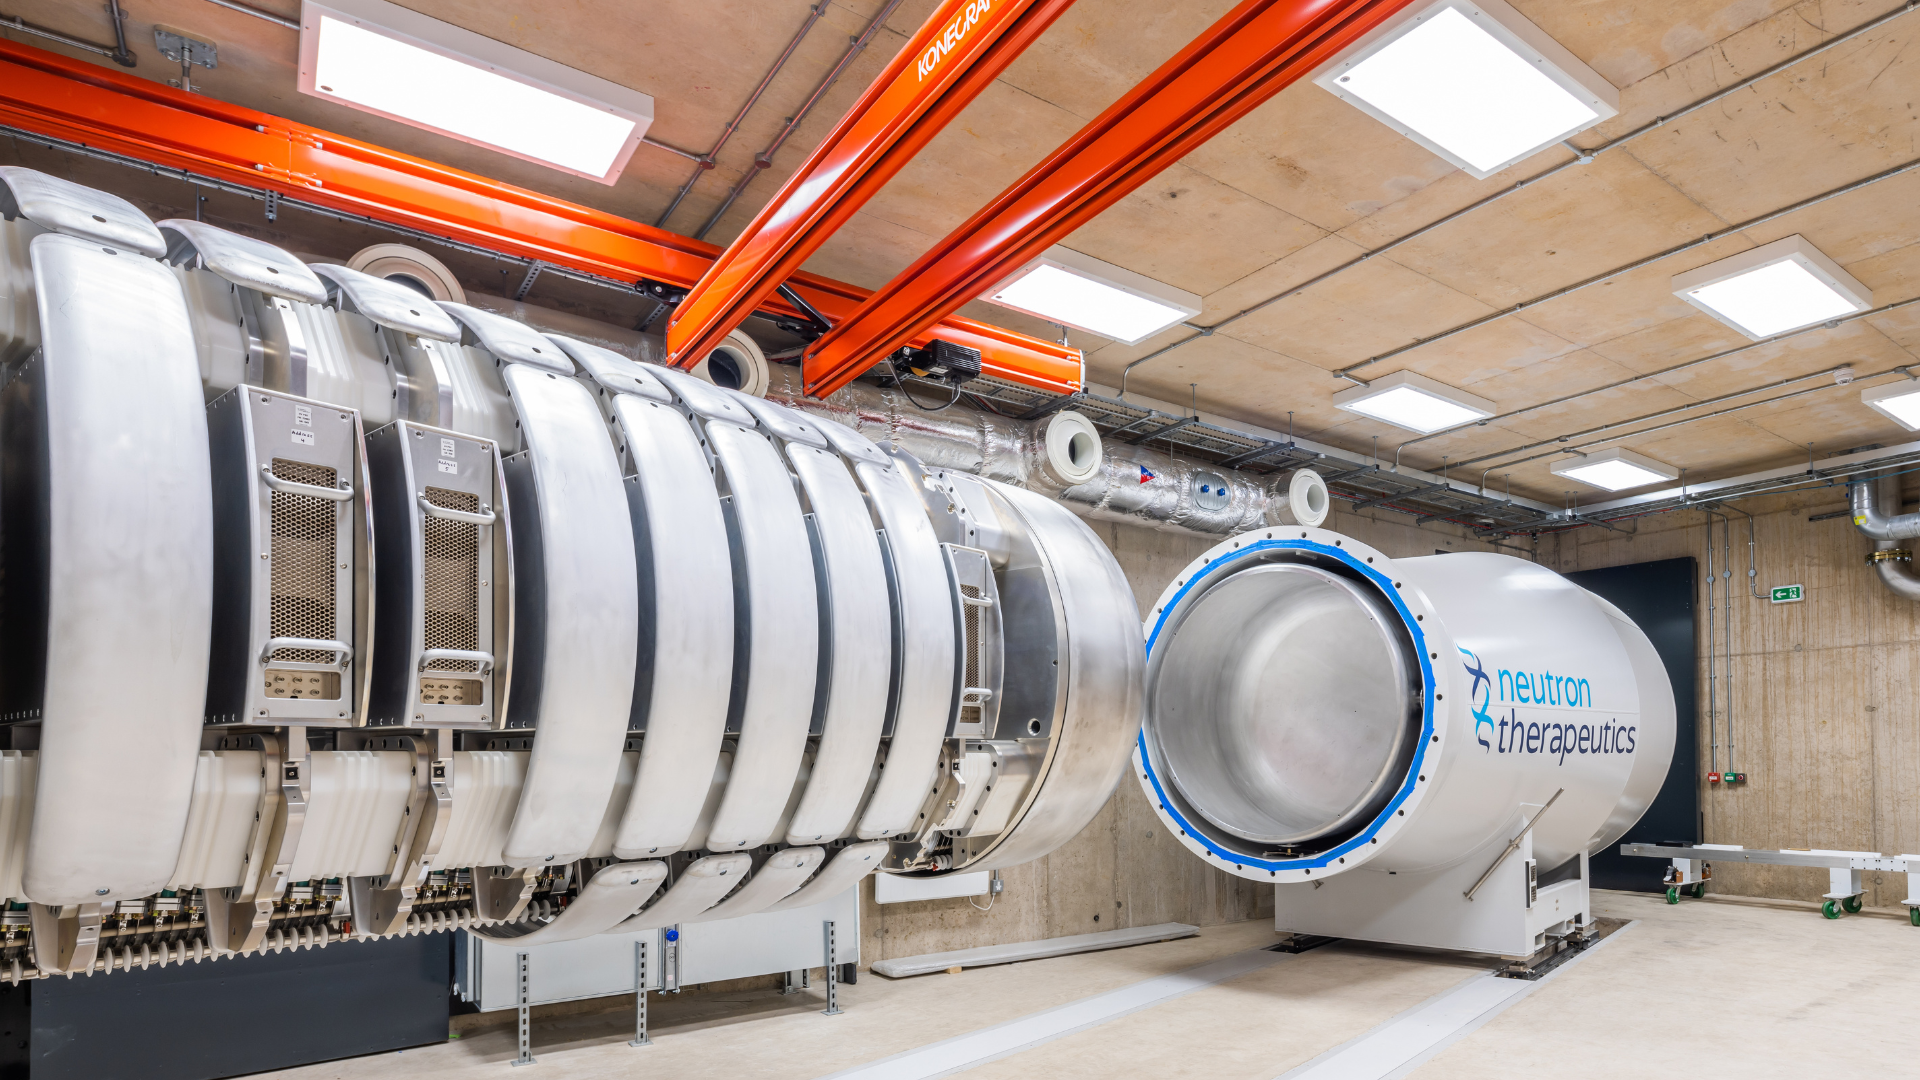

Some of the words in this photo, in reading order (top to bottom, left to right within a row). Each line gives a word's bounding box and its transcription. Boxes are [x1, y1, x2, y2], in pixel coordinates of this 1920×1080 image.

[918, 0, 997, 82] KONECRA
[1498, 669, 1592, 708] neutron
[1498, 708, 1636, 766] therapeutics
